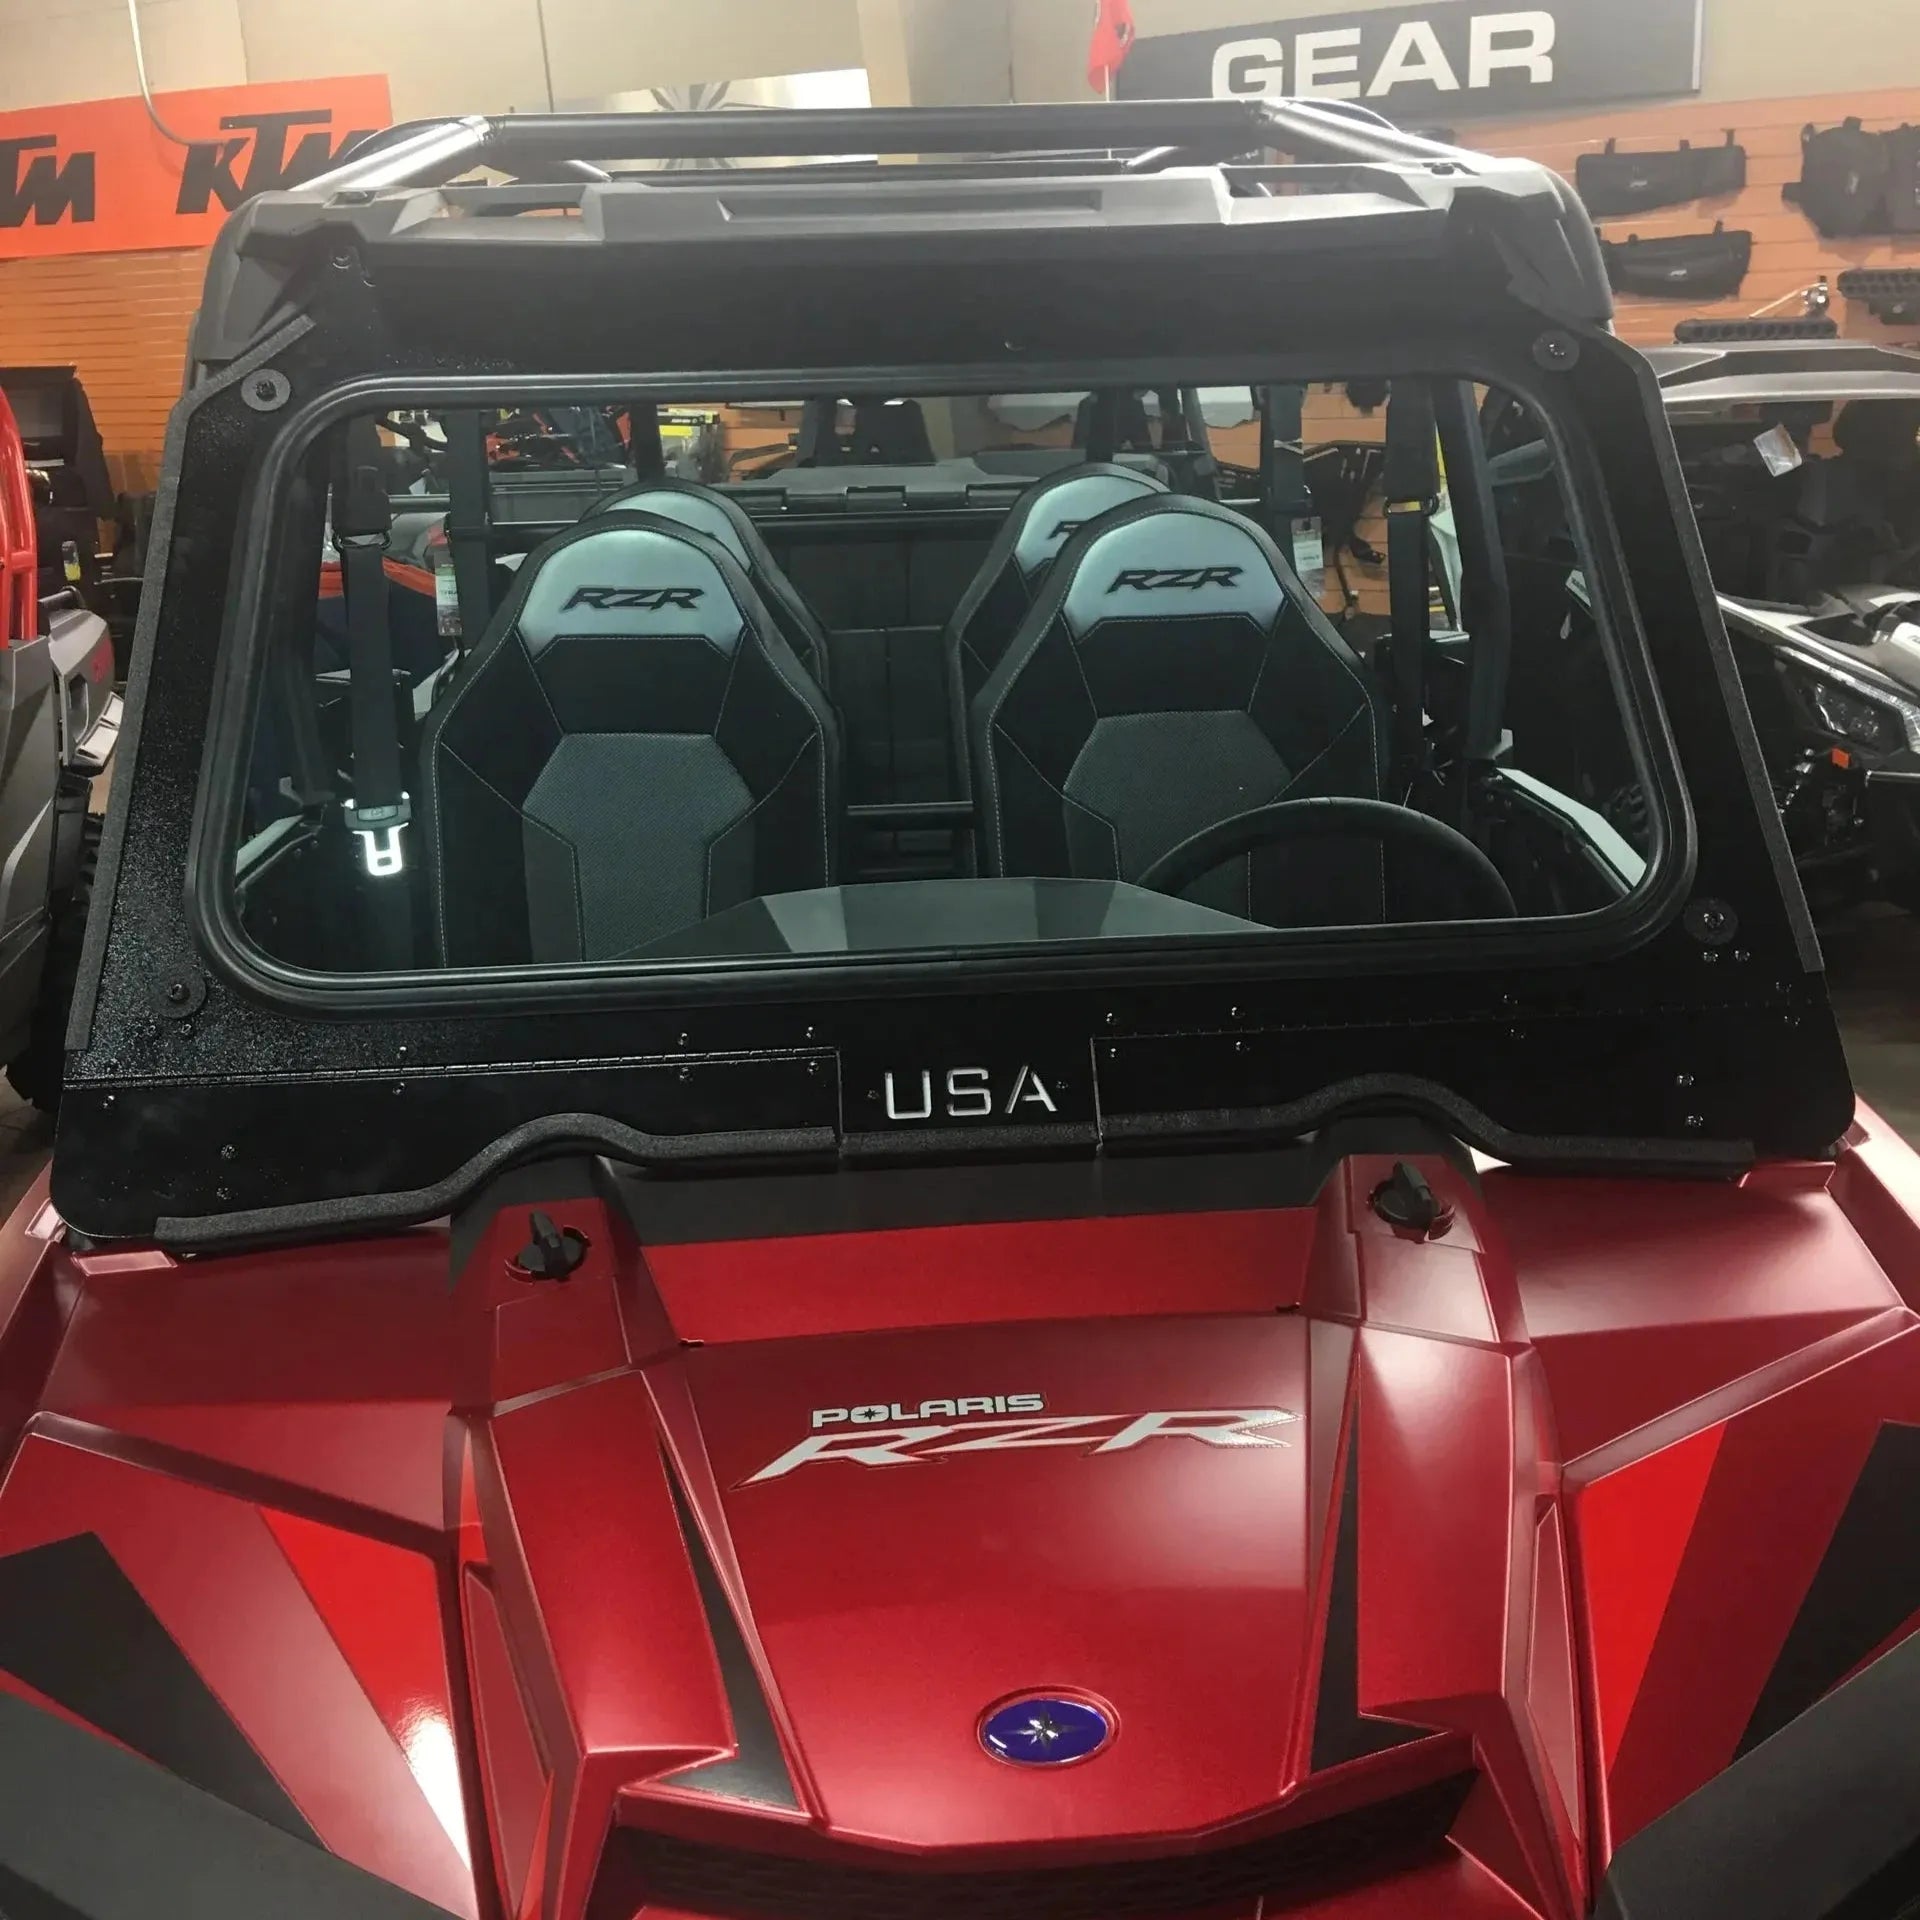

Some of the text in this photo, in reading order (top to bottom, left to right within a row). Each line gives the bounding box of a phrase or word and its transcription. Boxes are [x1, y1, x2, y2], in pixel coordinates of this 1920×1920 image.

[1212, 11, 1556, 100] GEAR
[561, 586, 705, 612] RZR
[1104, 566, 1244, 594] RZR
[885, 1065, 1058, 1120] USA
[812, 1393, 1044, 1427] POLARIS
[730, 1406, 1304, 1490] RZR
